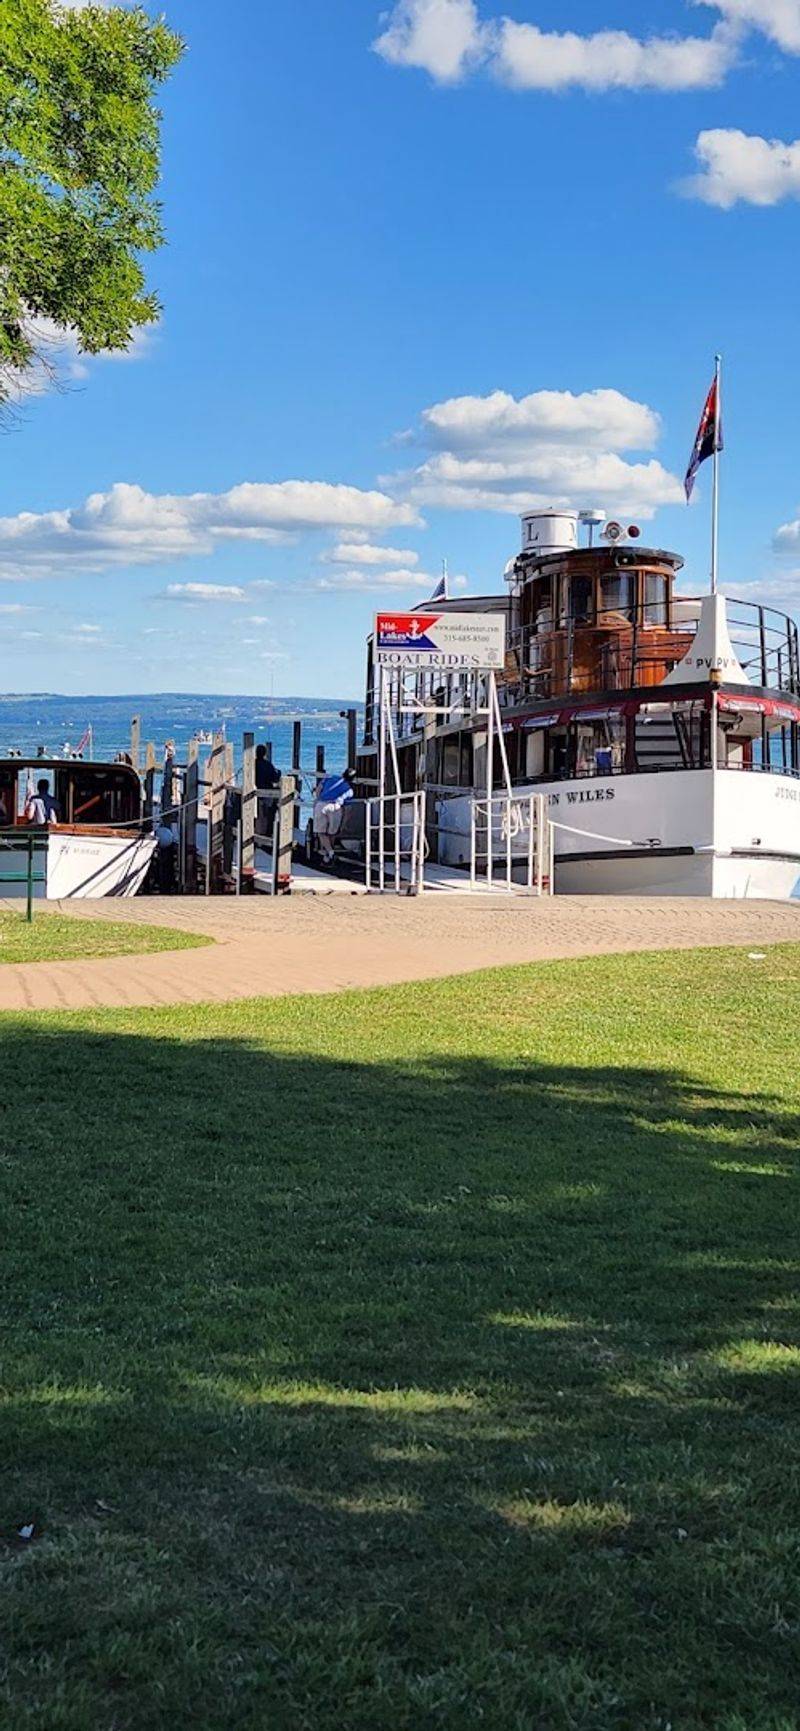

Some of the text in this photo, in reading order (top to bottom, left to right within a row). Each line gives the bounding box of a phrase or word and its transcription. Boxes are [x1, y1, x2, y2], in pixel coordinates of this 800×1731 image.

[379, 631, 407, 640] Lakes
[377, 652, 481, 665] BOAT RIDES
[696, 657, 712, 669] PV
[566, 788, 615, 805] WILES
